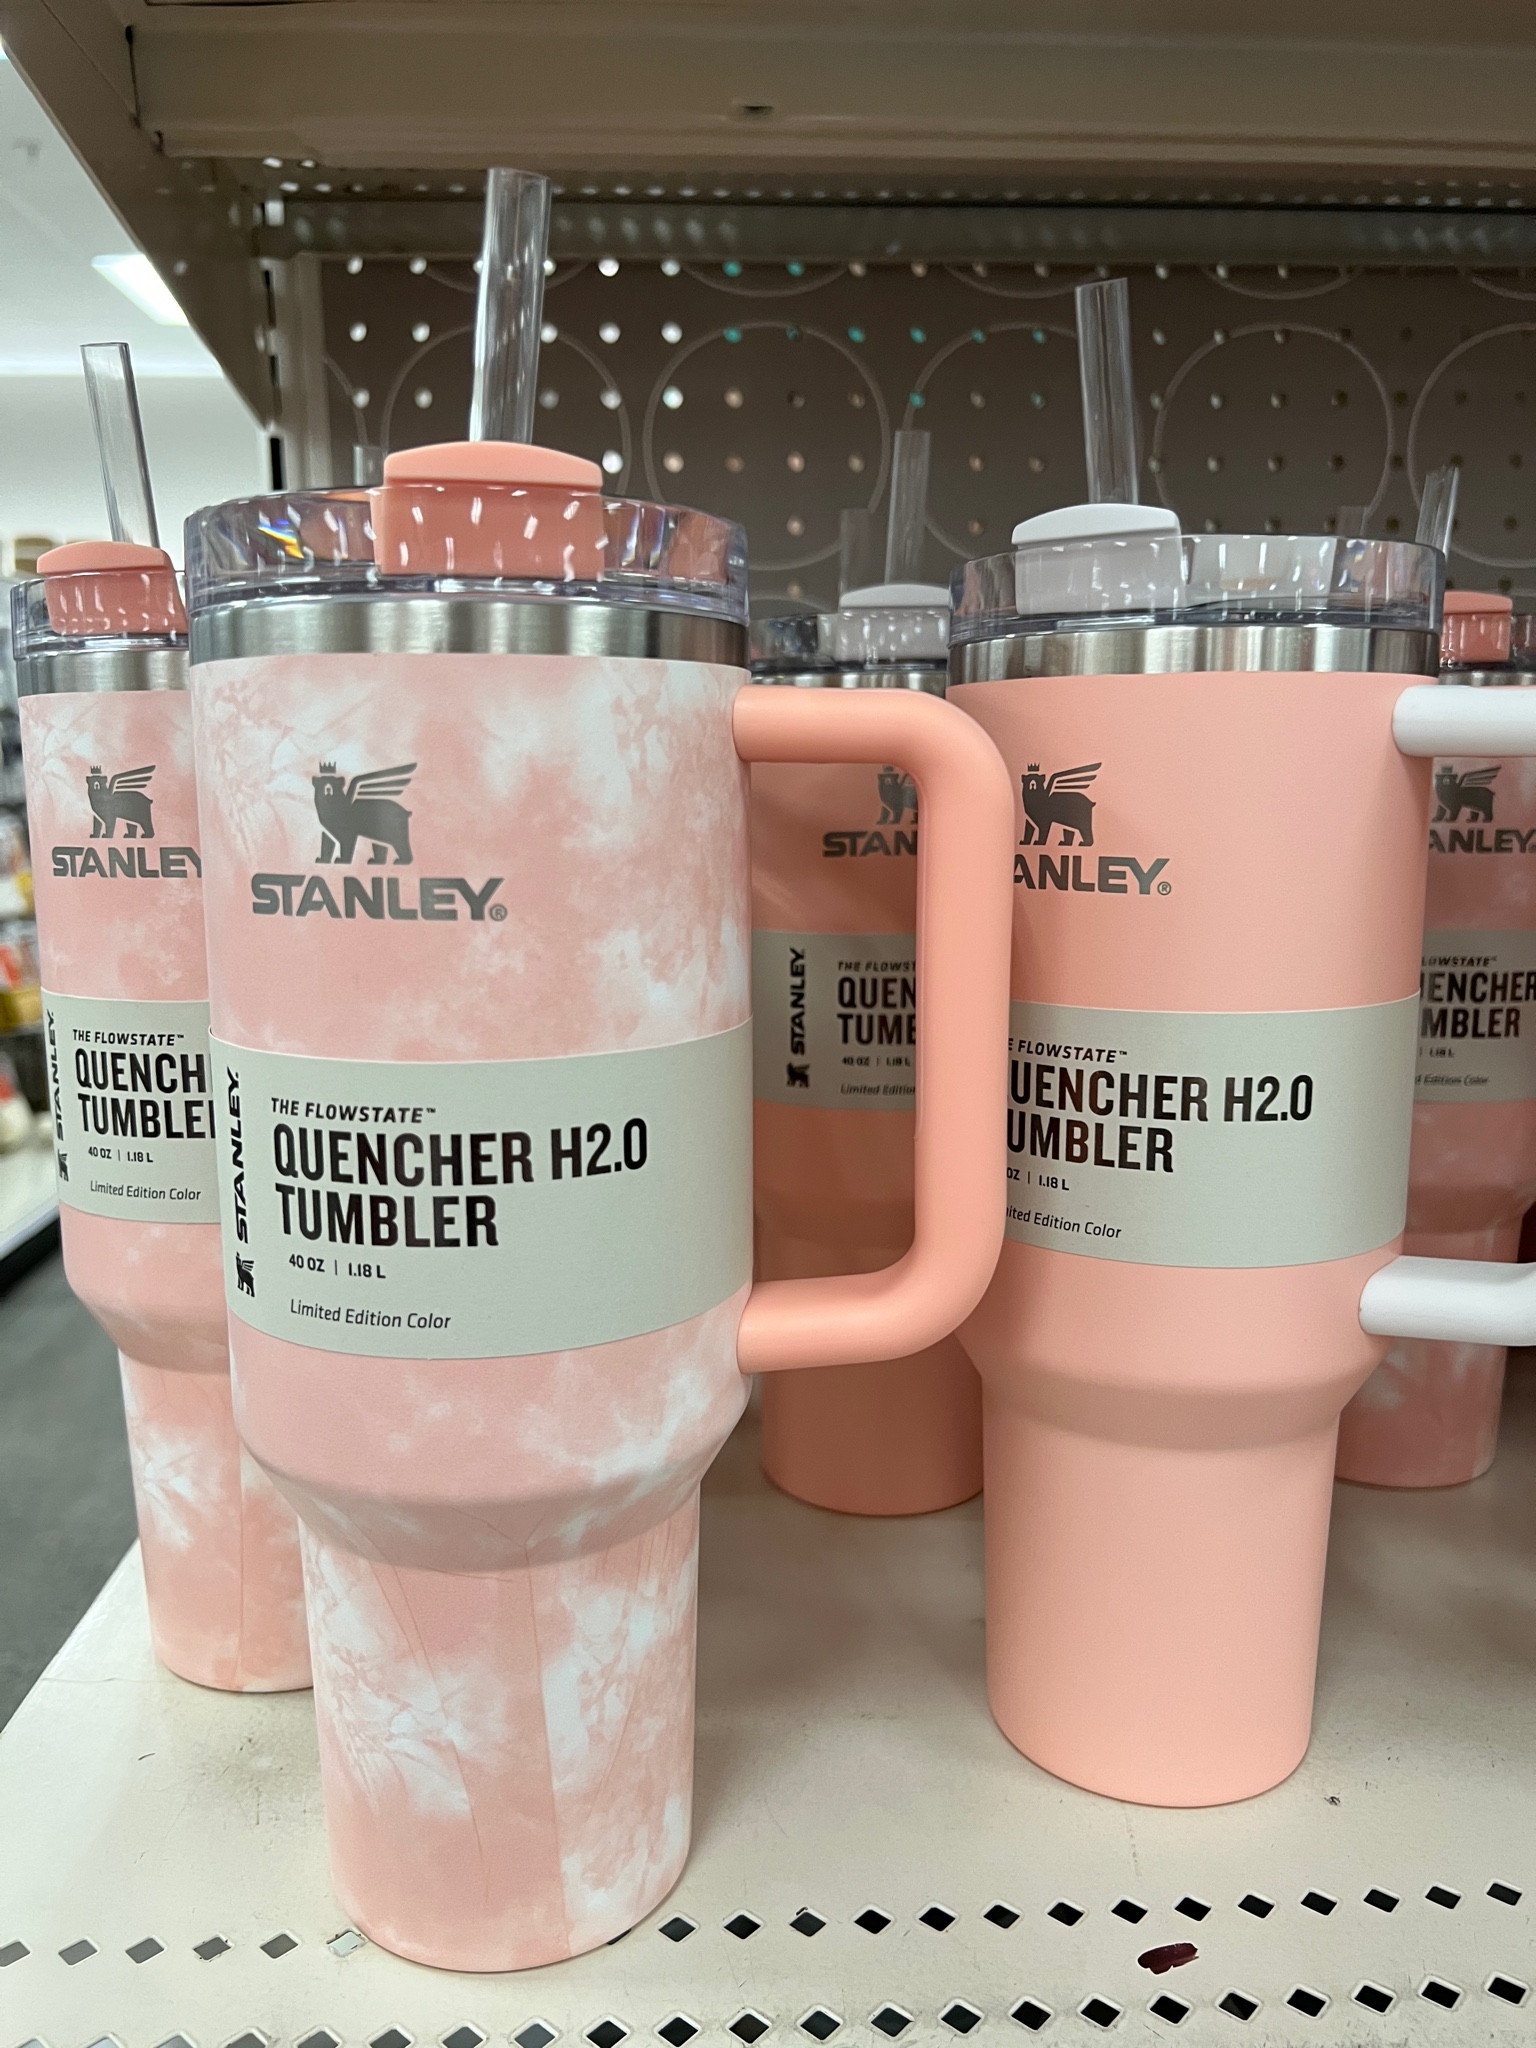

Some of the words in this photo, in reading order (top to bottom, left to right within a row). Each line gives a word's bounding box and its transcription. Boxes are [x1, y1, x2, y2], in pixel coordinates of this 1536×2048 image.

[823, 830, 917, 857] STAN
[1429, 829, 1536, 854] ANLEY
[1013, 853, 1172, 895] ANLEY®
[837, 961, 861, 972] THE
[865, 961, 916, 972] FLOWS
[789, 947, 805, 1055] STANLEY
[838, 976, 916, 1009] QUEN
[73, 1029, 91, 1042] THE
[1420, 1007, 1520, 1039] MBLER
[46, 1008, 64, 1141] STANLEY
[75, 1048, 207, 1094] QUENCH
[271, 1097, 299, 1116] THE
[1010, 1060, 1208, 1122] UENCHER
[1224, 1074, 1313, 1122] H2.0
[88, 1146, 98, 1158] 40
[99, 1148, 112, 1159] OZ
[127, 1151, 144, 1163] 1.18
[146, 1152, 154, 1163] L
[226, 1066, 248, 1244] STANLEY
[273, 1123, 534, 1187] QUENCHER
[551, 1117, 647, 1180] H2.0
[1007, 1109, 1173, 1173] UMBLER
[90, 1180, 124, 1196] Limited
[126, 1185, 166, 1200] Edition
[169, 1188, 202, 1201] Color
[1039, 1174, 1058, 1189] 1.18
[1061, 1178, 1069, 1190] L
[275, 1183, 499, 1247] TUMBLER
[1006, 1204, 1031, 1222] ited
[1034, 1212, 1081, 1233] Edition
[1084, 1221, 1122, 1239] Color
[289, 1253, 304, 1269] 40
[307, 1256, 325, 1273] OZ
[348, 1262, 372, 1278] 1.18
[376, 1264, 386, 1279] L
[290, 1298, 341, 1322] Limited
[345, 1308, 402, 1328] Edition
[407, 1312, 451, 1329] Color
